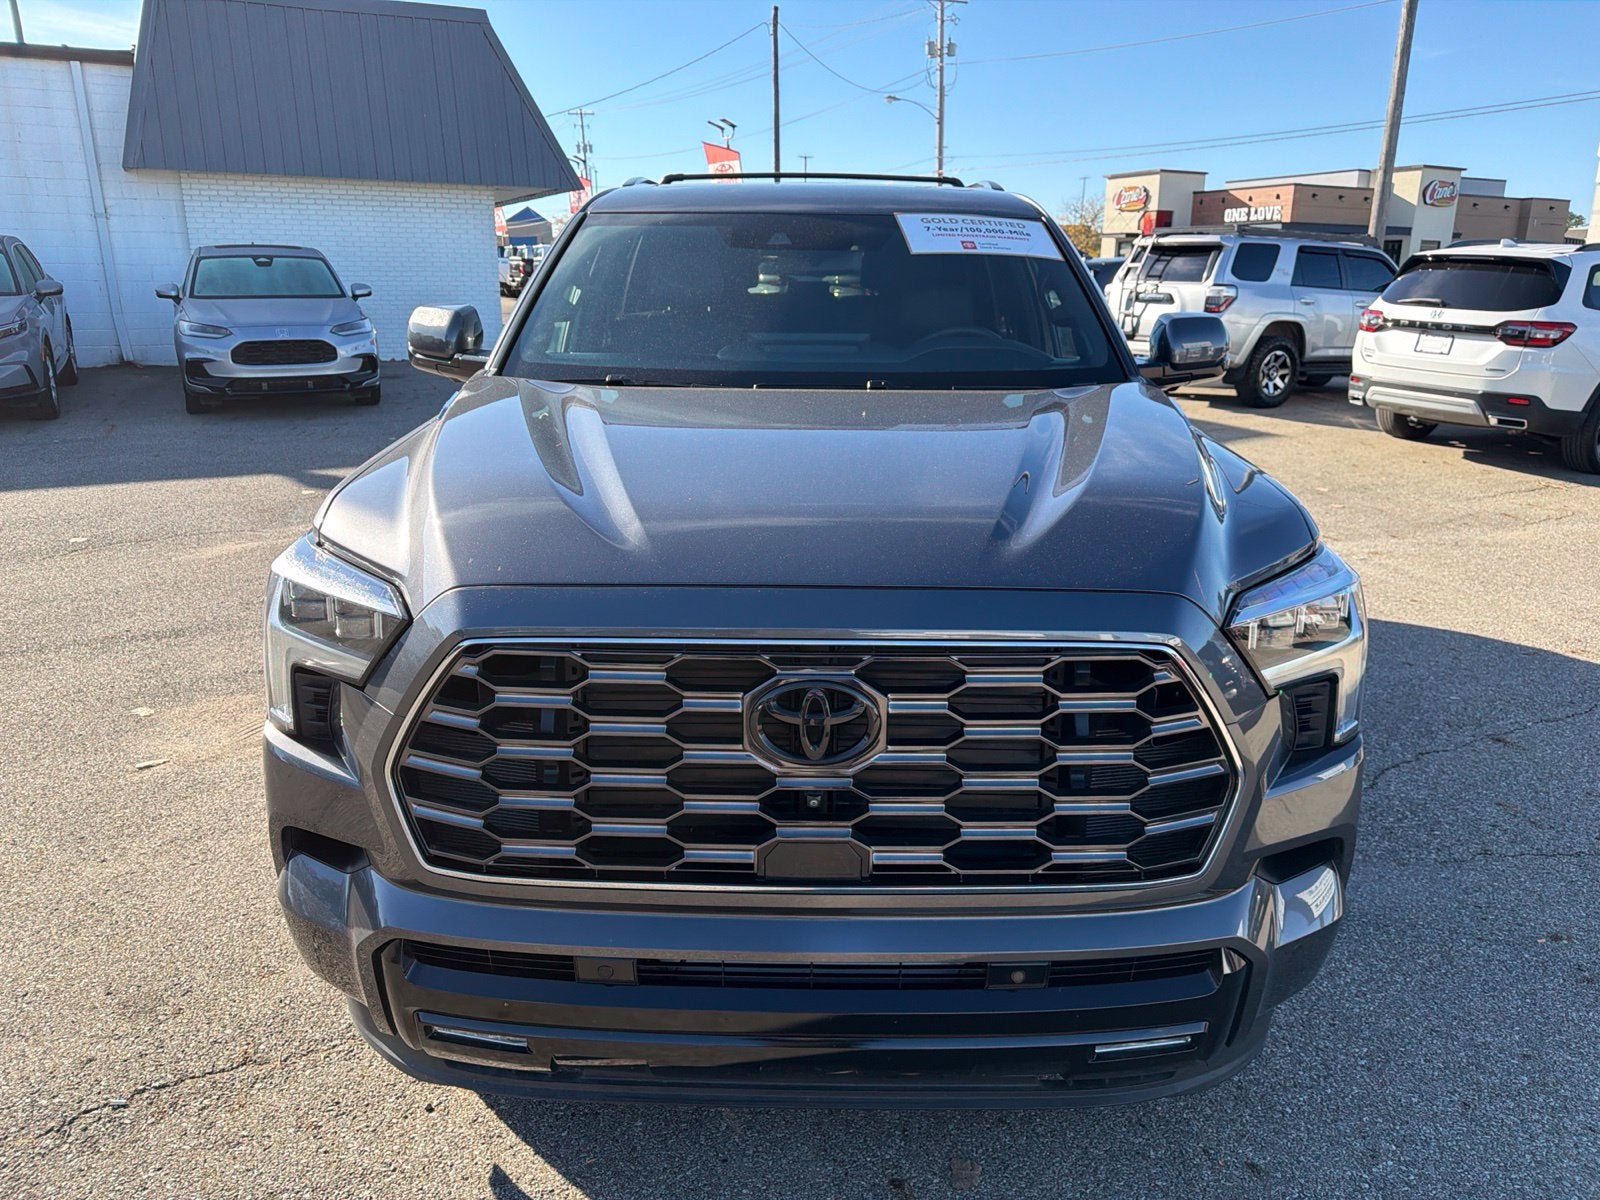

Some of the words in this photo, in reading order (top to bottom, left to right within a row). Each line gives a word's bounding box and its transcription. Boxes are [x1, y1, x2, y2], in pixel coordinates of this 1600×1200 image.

[1112, 186, 1147, 210] Cane's
[1425, 179, 1458, 204] Cane's
[1223, 207, 1249, 223] ONE
[1249, 205, 1282, 221] LOVE
[962, 218, 1026, 229] CERTIFIED
[1399, 320, 1468, 331] PILOT
